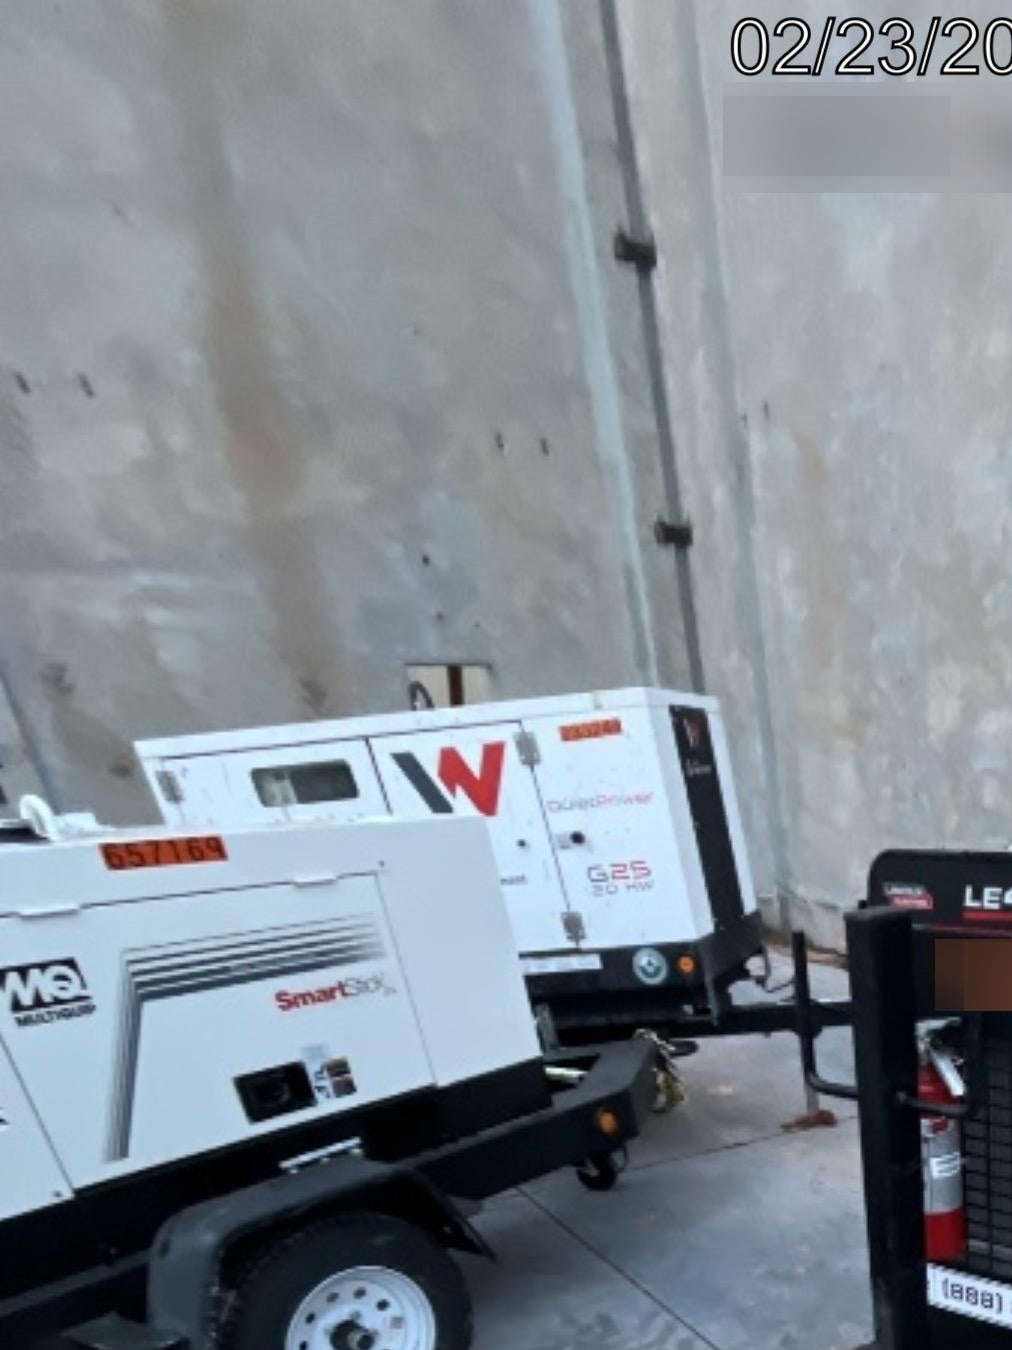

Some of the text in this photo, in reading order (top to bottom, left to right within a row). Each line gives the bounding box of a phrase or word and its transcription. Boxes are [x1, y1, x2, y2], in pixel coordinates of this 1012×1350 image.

[100, 836, 229, 870] 657169
[587, 860, 652, 884] G25
[2, 965, 84, 1007] MQ
[942, 1276, 1003, 1313] (888)
